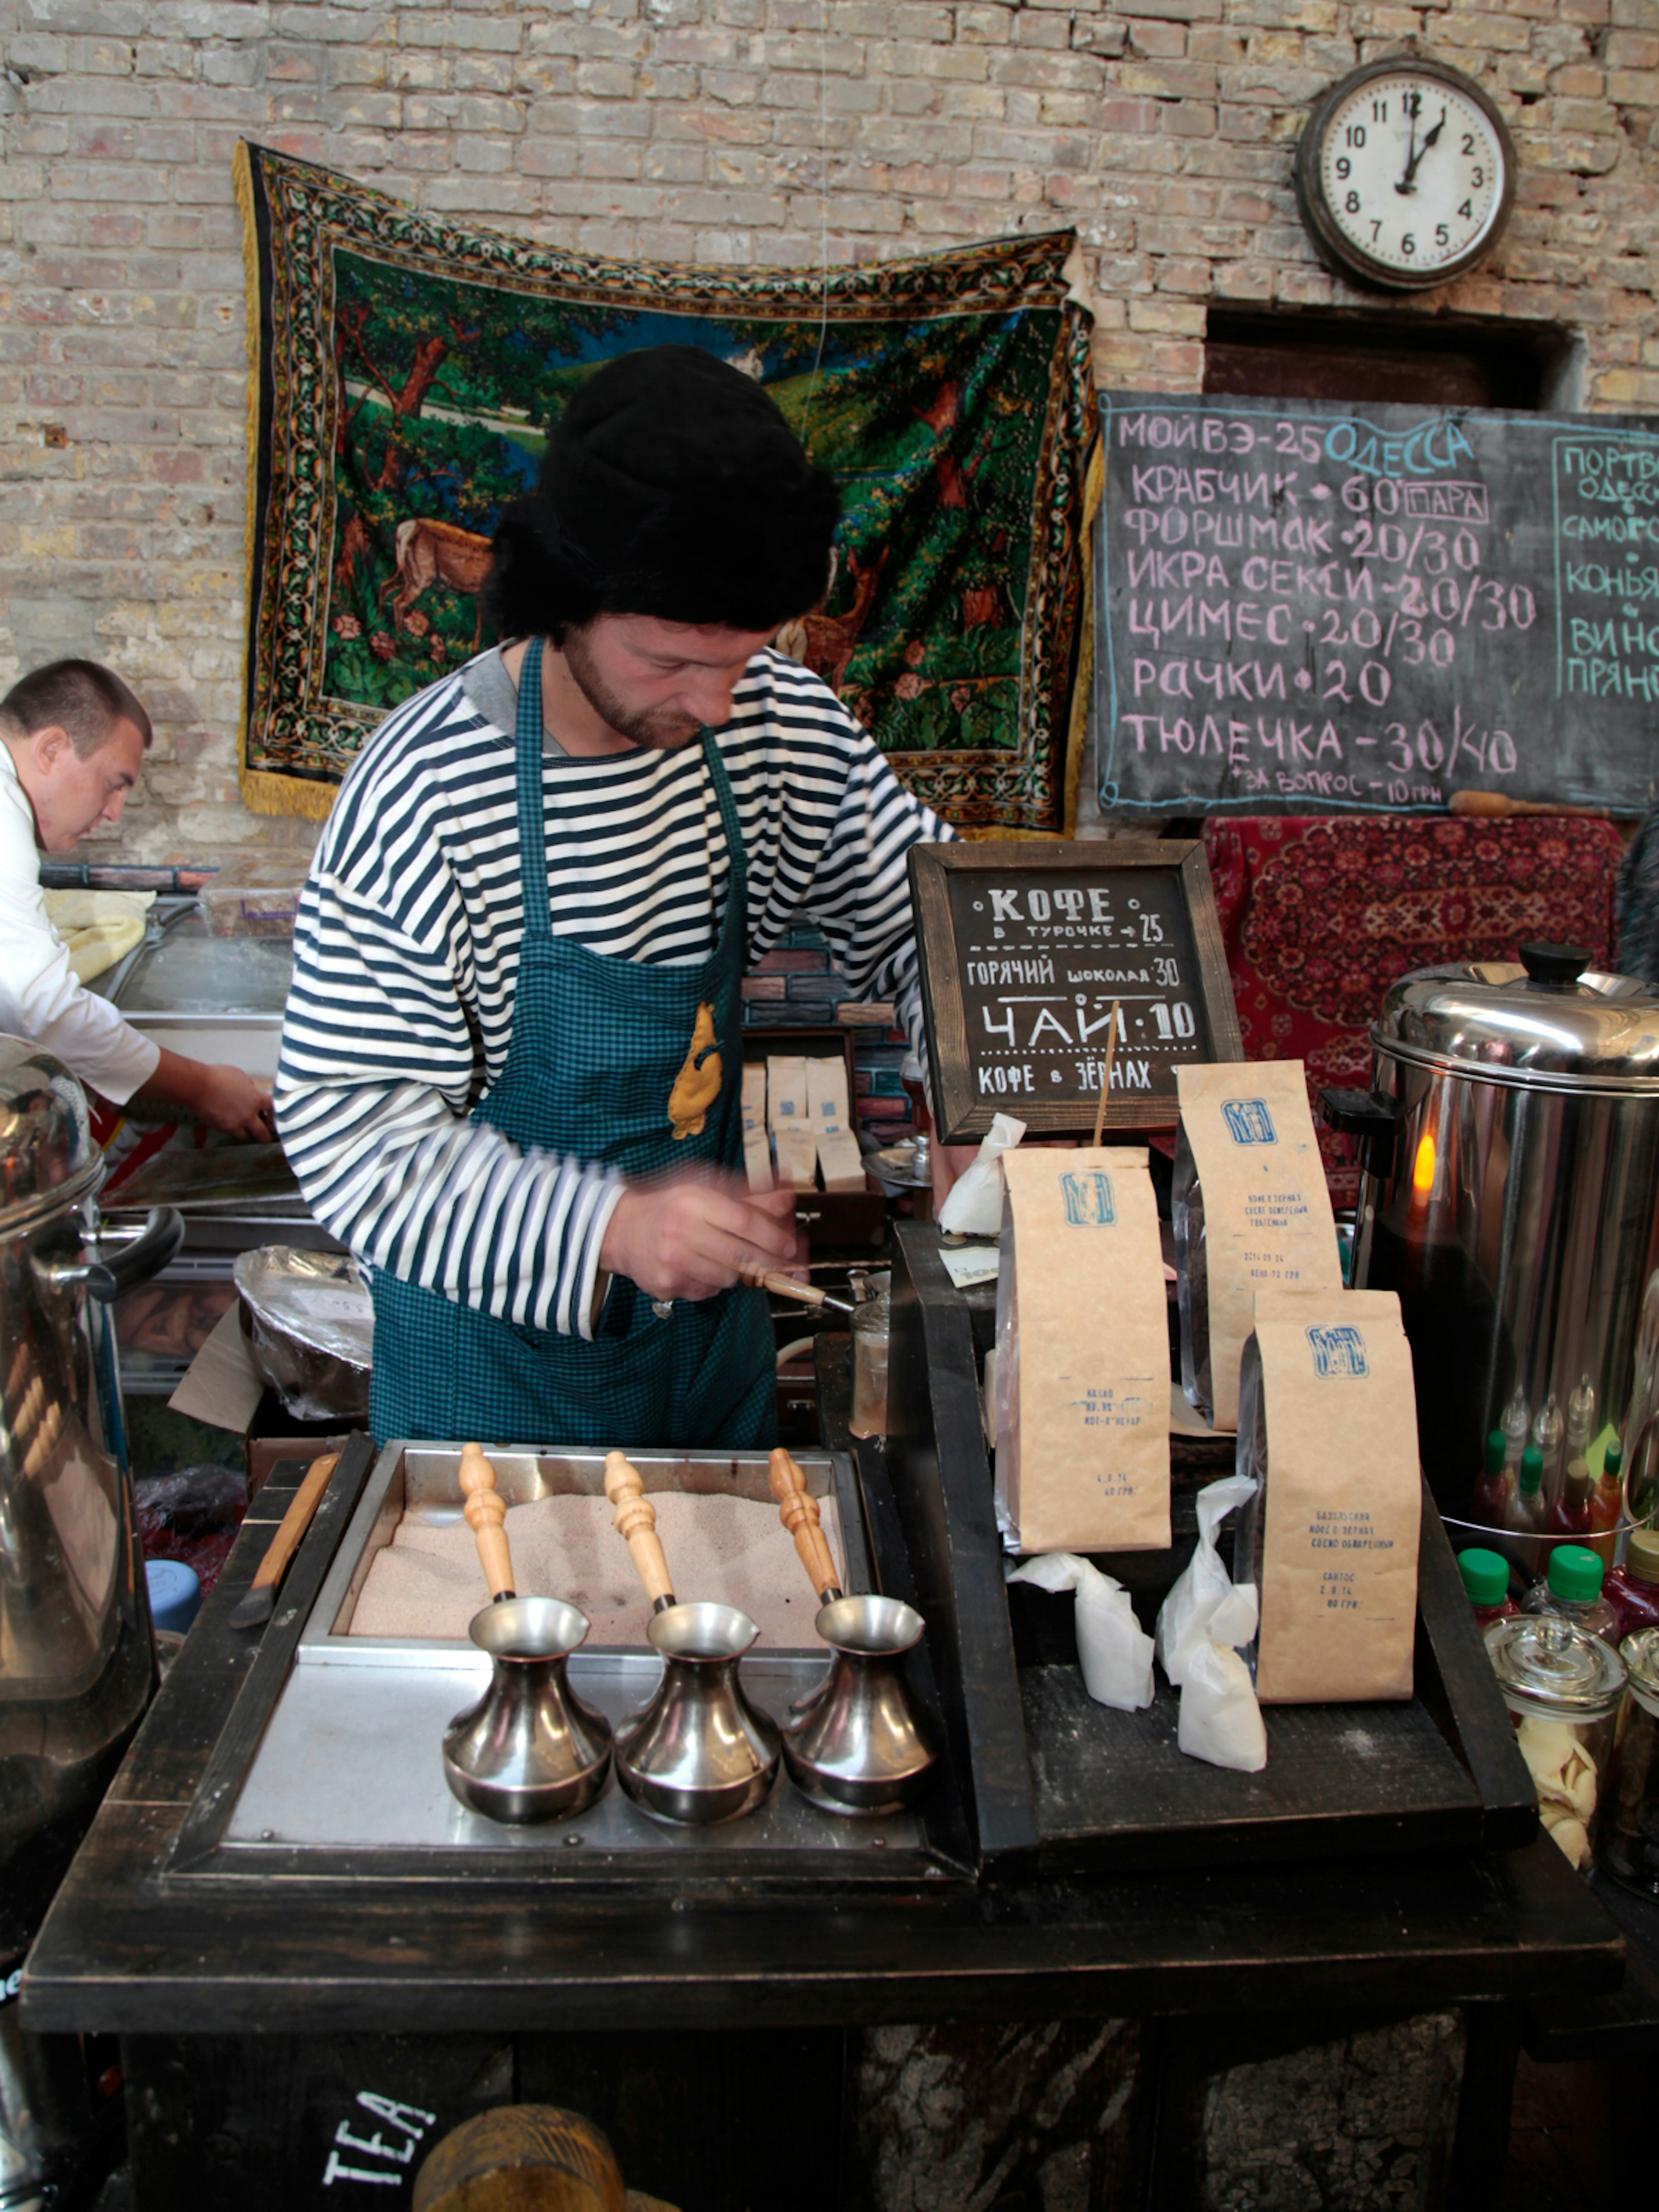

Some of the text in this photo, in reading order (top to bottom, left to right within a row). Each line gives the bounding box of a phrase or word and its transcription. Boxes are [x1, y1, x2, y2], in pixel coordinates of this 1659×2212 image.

[1373, 99, 1387, 123] 11
[1403, 92, 1421, 114] 12
[1346, 125, 1366, 148] 10
[1461, 134, 1475, 156] 2
[1337, 157, 1351, 179] 9
[1472, 166, 1484, 188] 3
[1346, 191, 1360, 213] 8
[1459, 199, 1472, 220] 4
[1370, 220, 1382, 242] 7
[1402, 234, 1414, 254] 6
[1436, 223, 1449, 246] 5
[1325, 422, 1474, 477] ОДЕССА
[1564, 446, 1659, 479] ПОРТВ
[1132, 464, 1297, 507] КРАБЧИК
[1409, 486, 1484, 518] ПАРА
[1578, 476, 1659, 506] ОДЕСС
[1351, 519, 1480, 575] 20/30
[1127, 550, 1230, 588] ИКРА
[1242, 556, 1374, 602] СЕКСИ
[1129, 594, 1456, 667] ЦИМЕС 20/30
[1133, 658, 1391, 706] РАЧКИ 20
[1121, 714, 1344, 765] ТЮЛЕЧКА
[1385, 704, 1518, 778] 30/40
[1276, 771, 1363, 795] ВОПРОС
[1388, 778, 1409, 803] 10
[988, 888, 1114, 922] КОФЕ
[993, 913, 1163, 942] В ТУРОЧКЕ 25
[967, 954, 1055, 986] ГОРЯЧИЙ
[1154, 958, 1180, 986] 30
[982, 1001, 1195, 1047] ЧАЙ 10
[978, 1056, 1151, 1094] КОФЕ В ЗЁРНАХ
[323, 2091, 436, 2186] TEA
